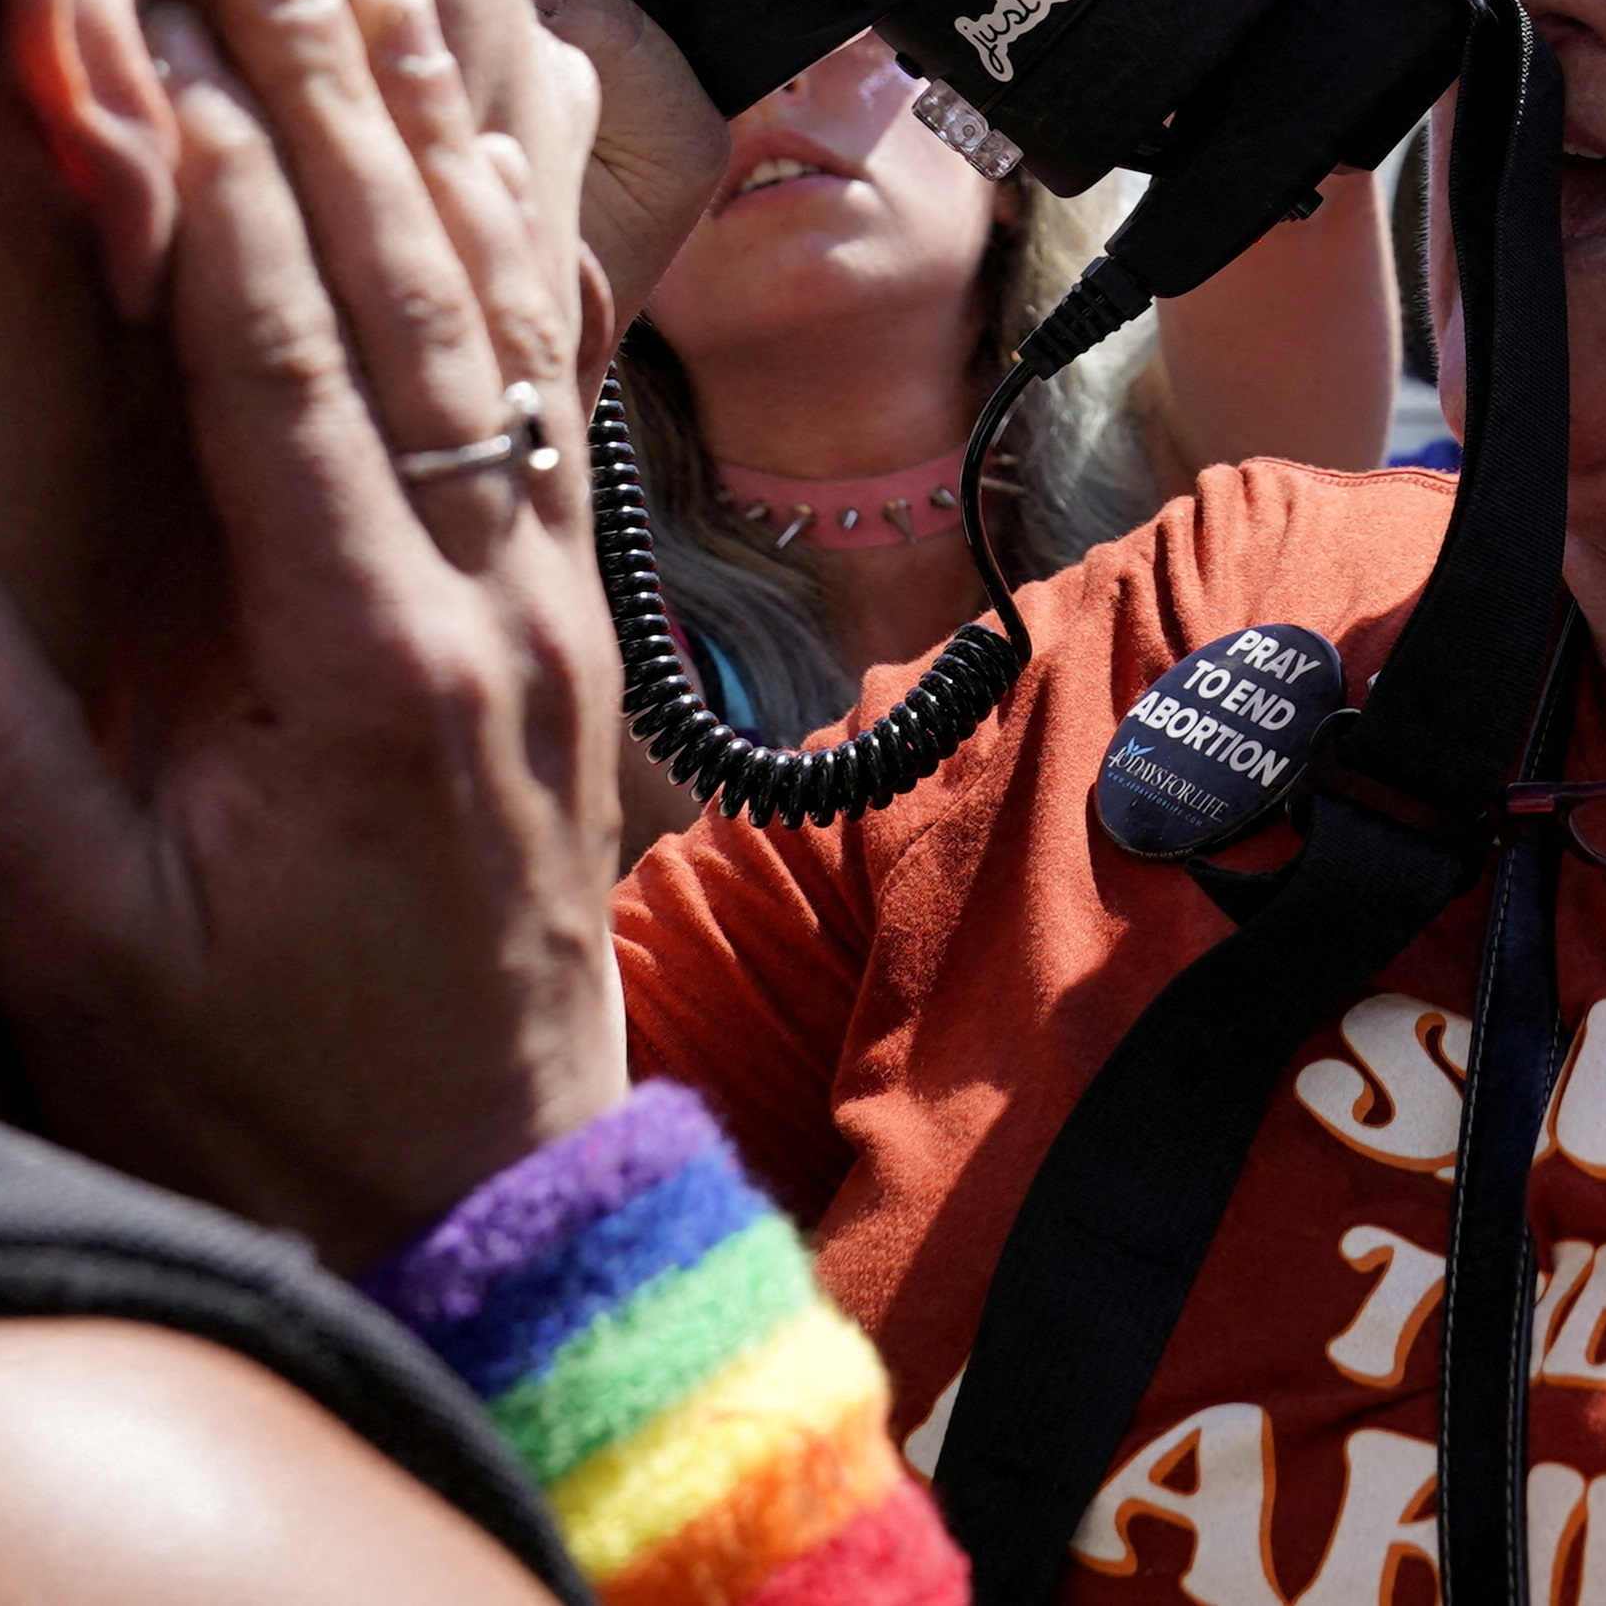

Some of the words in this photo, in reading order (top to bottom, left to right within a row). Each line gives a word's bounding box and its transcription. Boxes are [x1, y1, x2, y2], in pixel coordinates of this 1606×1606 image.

[1225, 629, 1322, 685] PRAY
[1183, 659, 1232, 699] TO
[1220, 678, 1297, 732] END
[1127, 690, 1290, 788] ABORTION
